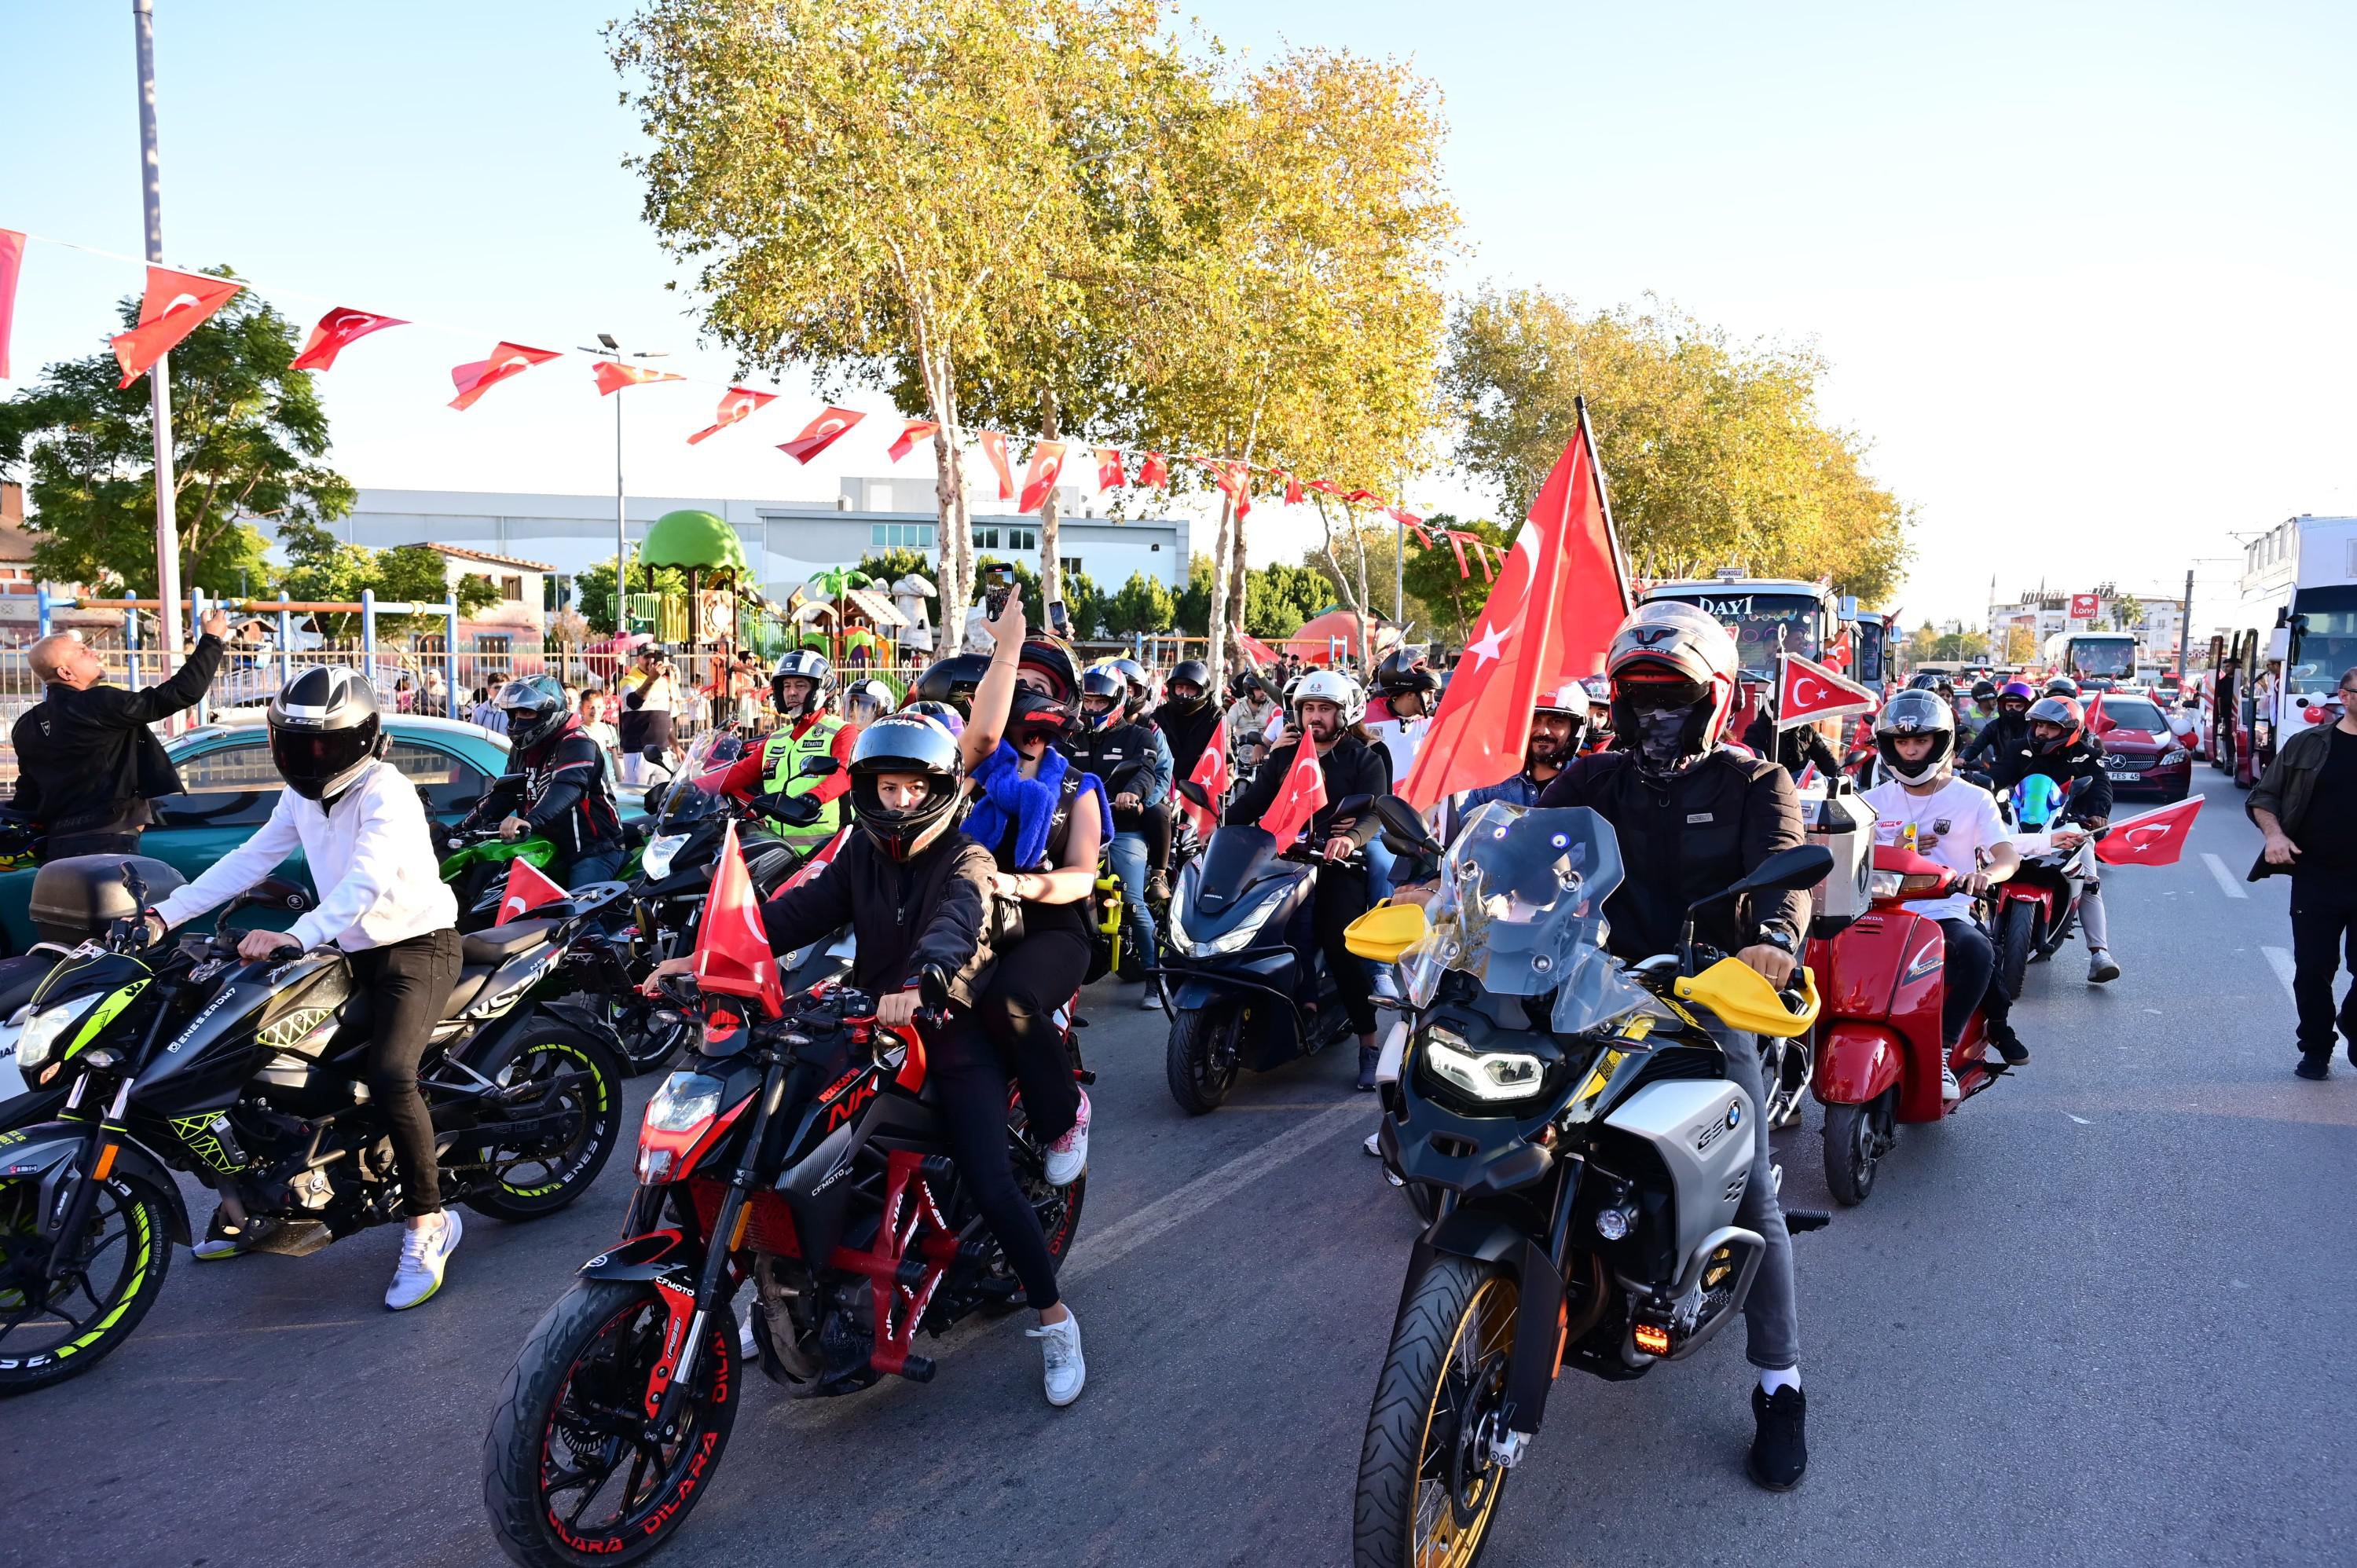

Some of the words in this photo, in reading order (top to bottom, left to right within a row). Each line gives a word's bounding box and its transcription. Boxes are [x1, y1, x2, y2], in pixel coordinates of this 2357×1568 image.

[1699, 595, 1754, 615] DAYI
[2074, 606, 2096, 617] Long
[284, 717, 324, 726] LS2
[827, 1073, 876, 1133] NK
[1698, 1116, 1725, 1150] GS
[561, 1139, 598, 1184] ENES
[812, 1169, 845, 1196] CFMOTO
[655, 1276, 697, 1297] CFMOTO
[640, 1432, 718, 1535] DILARA
[548, 1509, 624, 1553] DILARA
